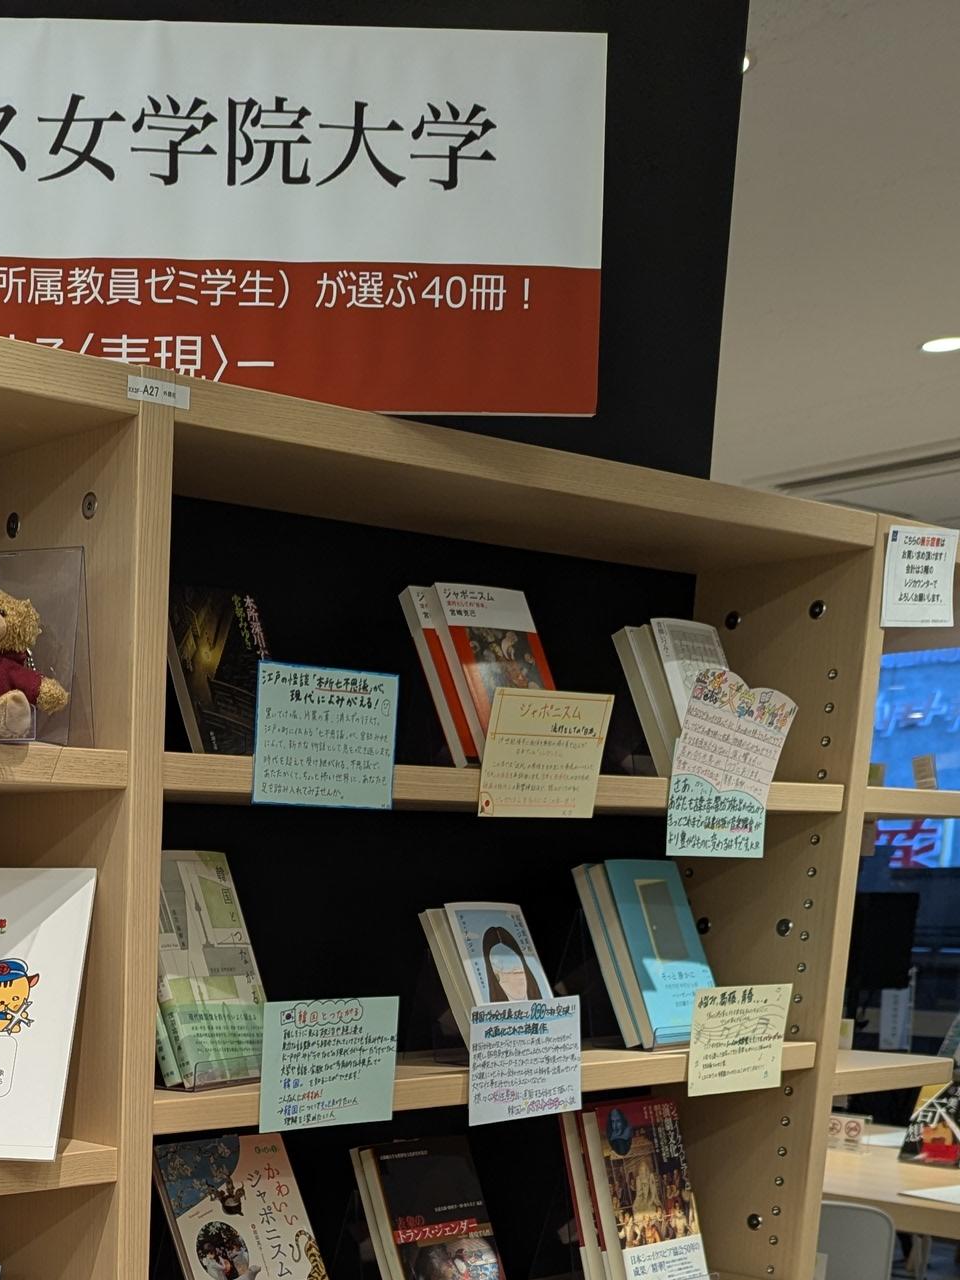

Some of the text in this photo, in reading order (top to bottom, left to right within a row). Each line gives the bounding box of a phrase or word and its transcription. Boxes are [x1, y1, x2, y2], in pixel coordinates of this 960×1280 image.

[443, 588, 494, 601] ジャポニスム
[520, 703, 581, 720] ジャポニスム
[263, 1163, 299, 1226] かわいい
[247, 1170, 292, 1278] ジャポニスム
[399, 1220, 478, 1244] トランス・ジェンダー
